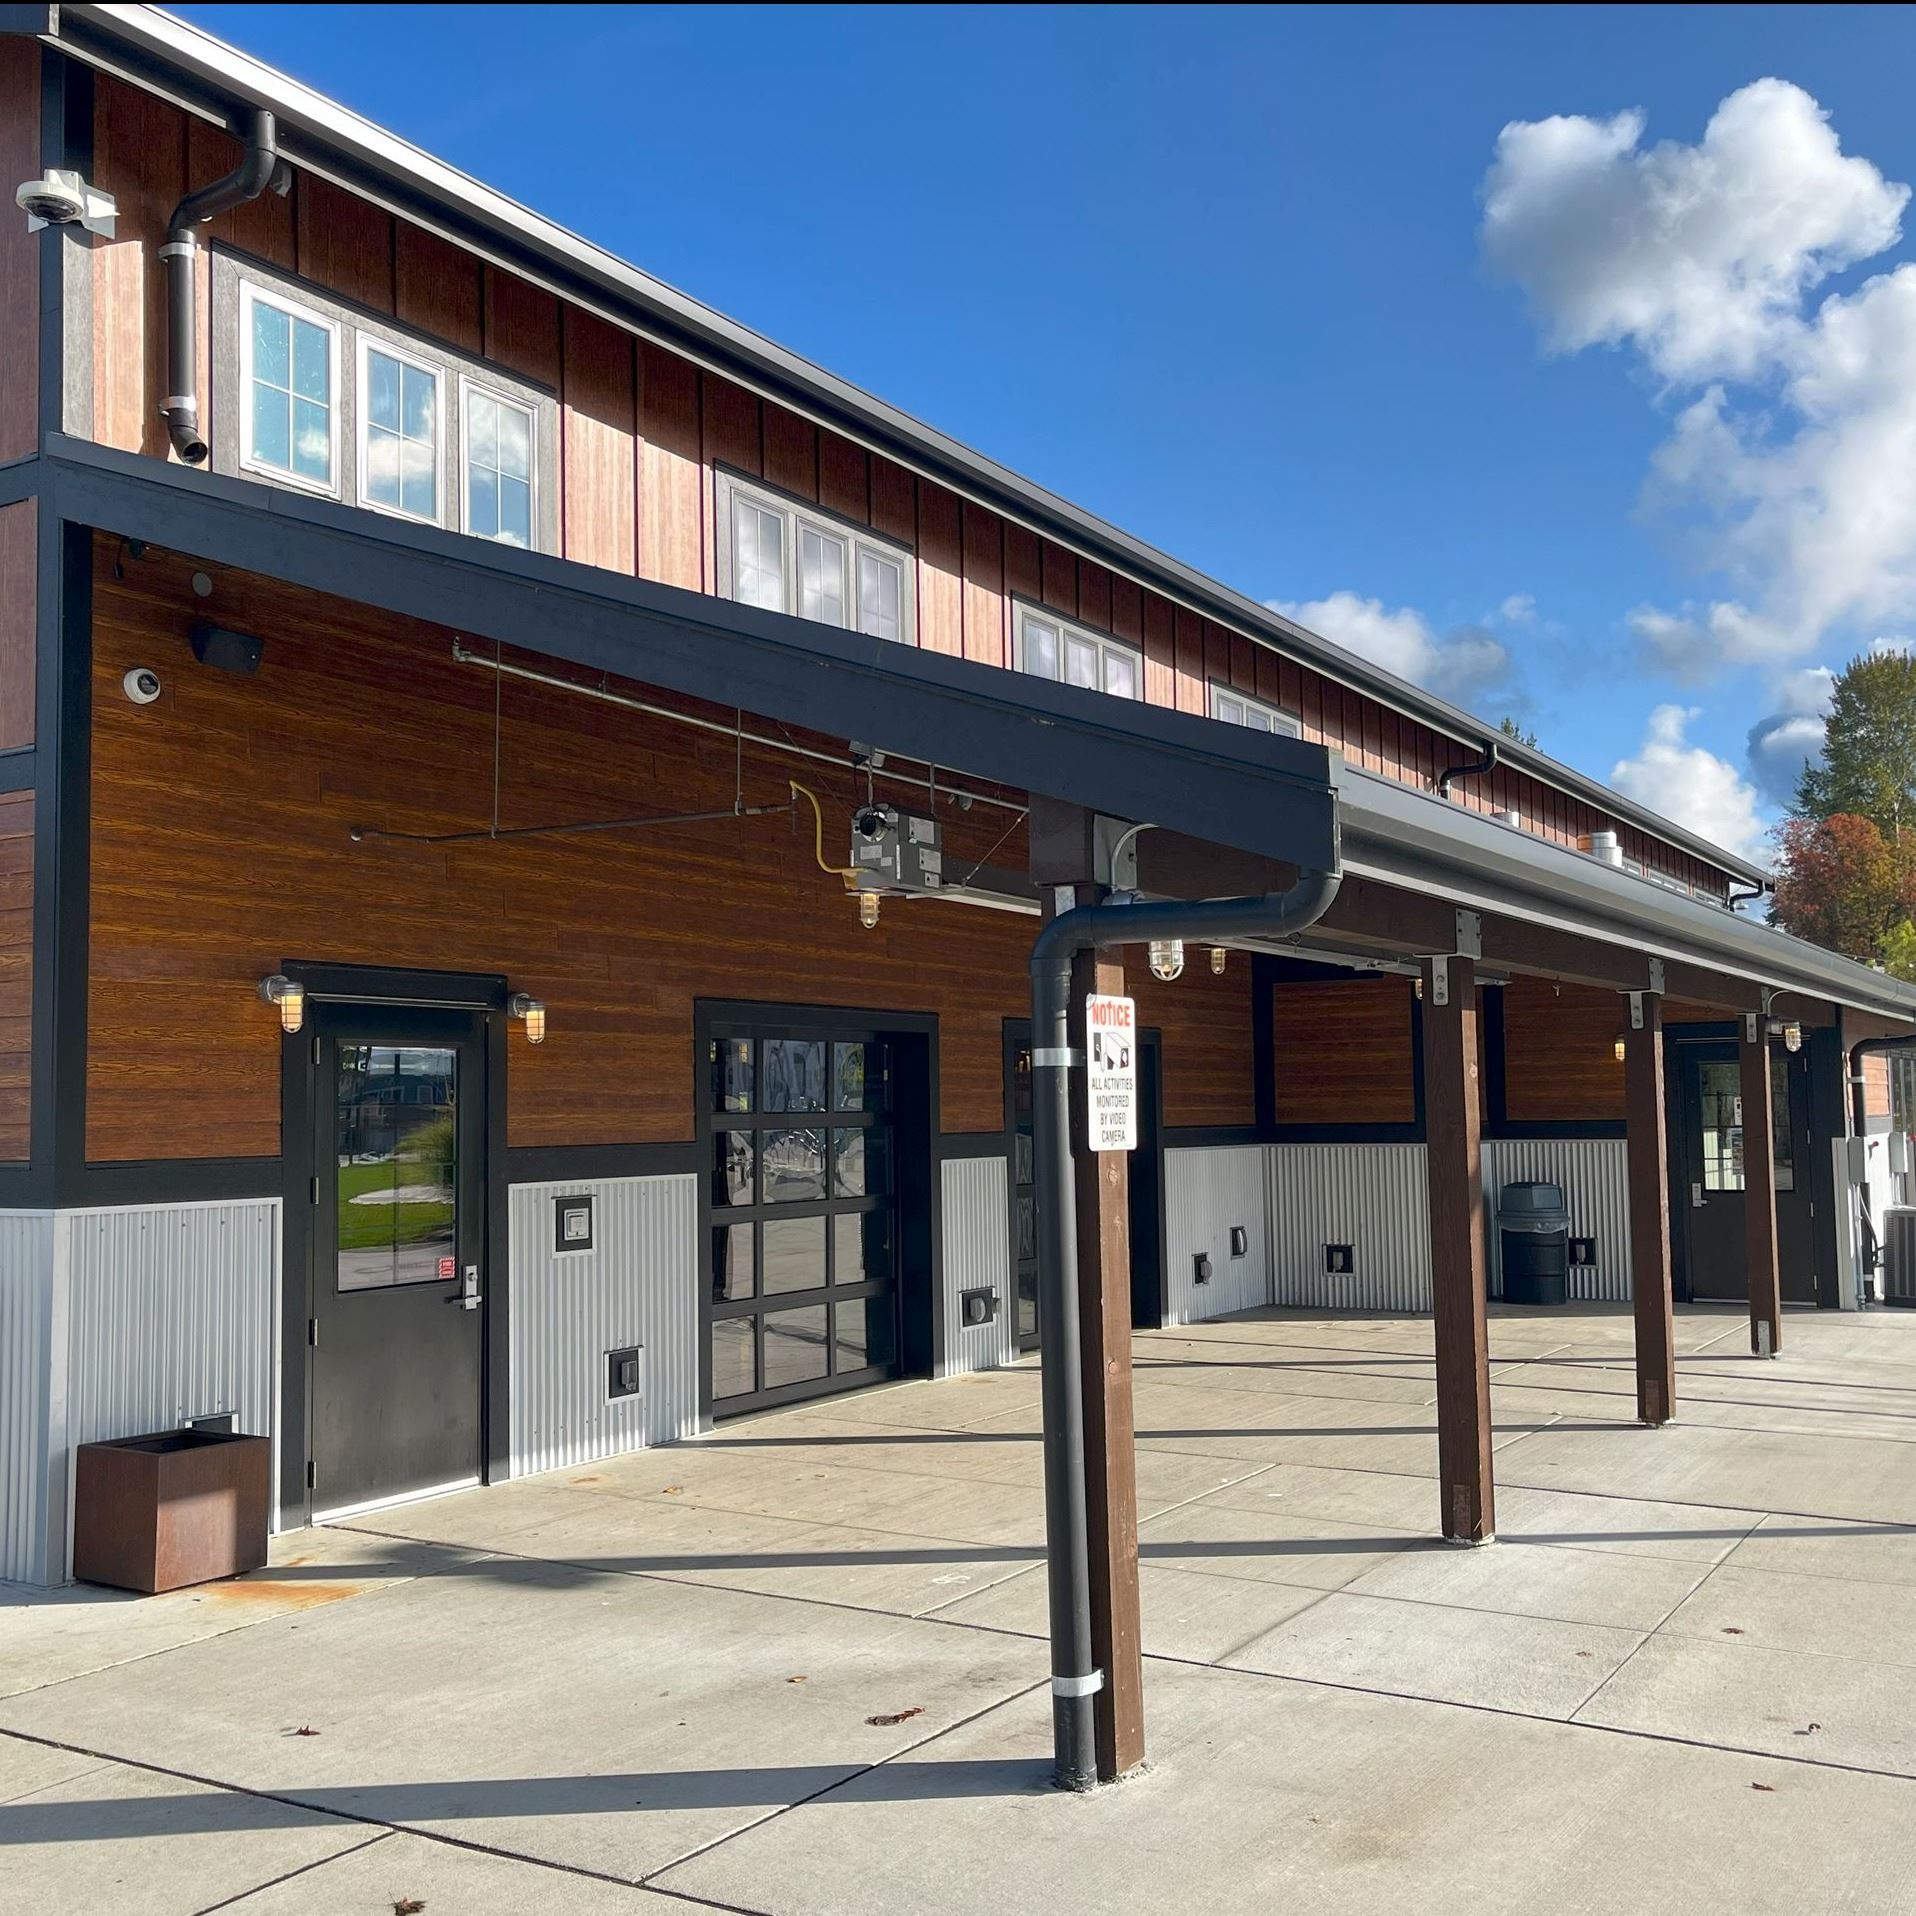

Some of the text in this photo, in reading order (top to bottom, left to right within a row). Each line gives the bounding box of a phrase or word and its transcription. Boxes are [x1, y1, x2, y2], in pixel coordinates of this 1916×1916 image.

[1092, 1001, 1131, 1027] NOTICE
[1092, 1077, 1133, 1091] ALL ACTIVITIES
[1096, 1095, 1130, 1108] MONITORED
[1100, 1112, 1126, 1125] BY VIDEO
[1101, 1129, 1126, 1143] CAMERA
